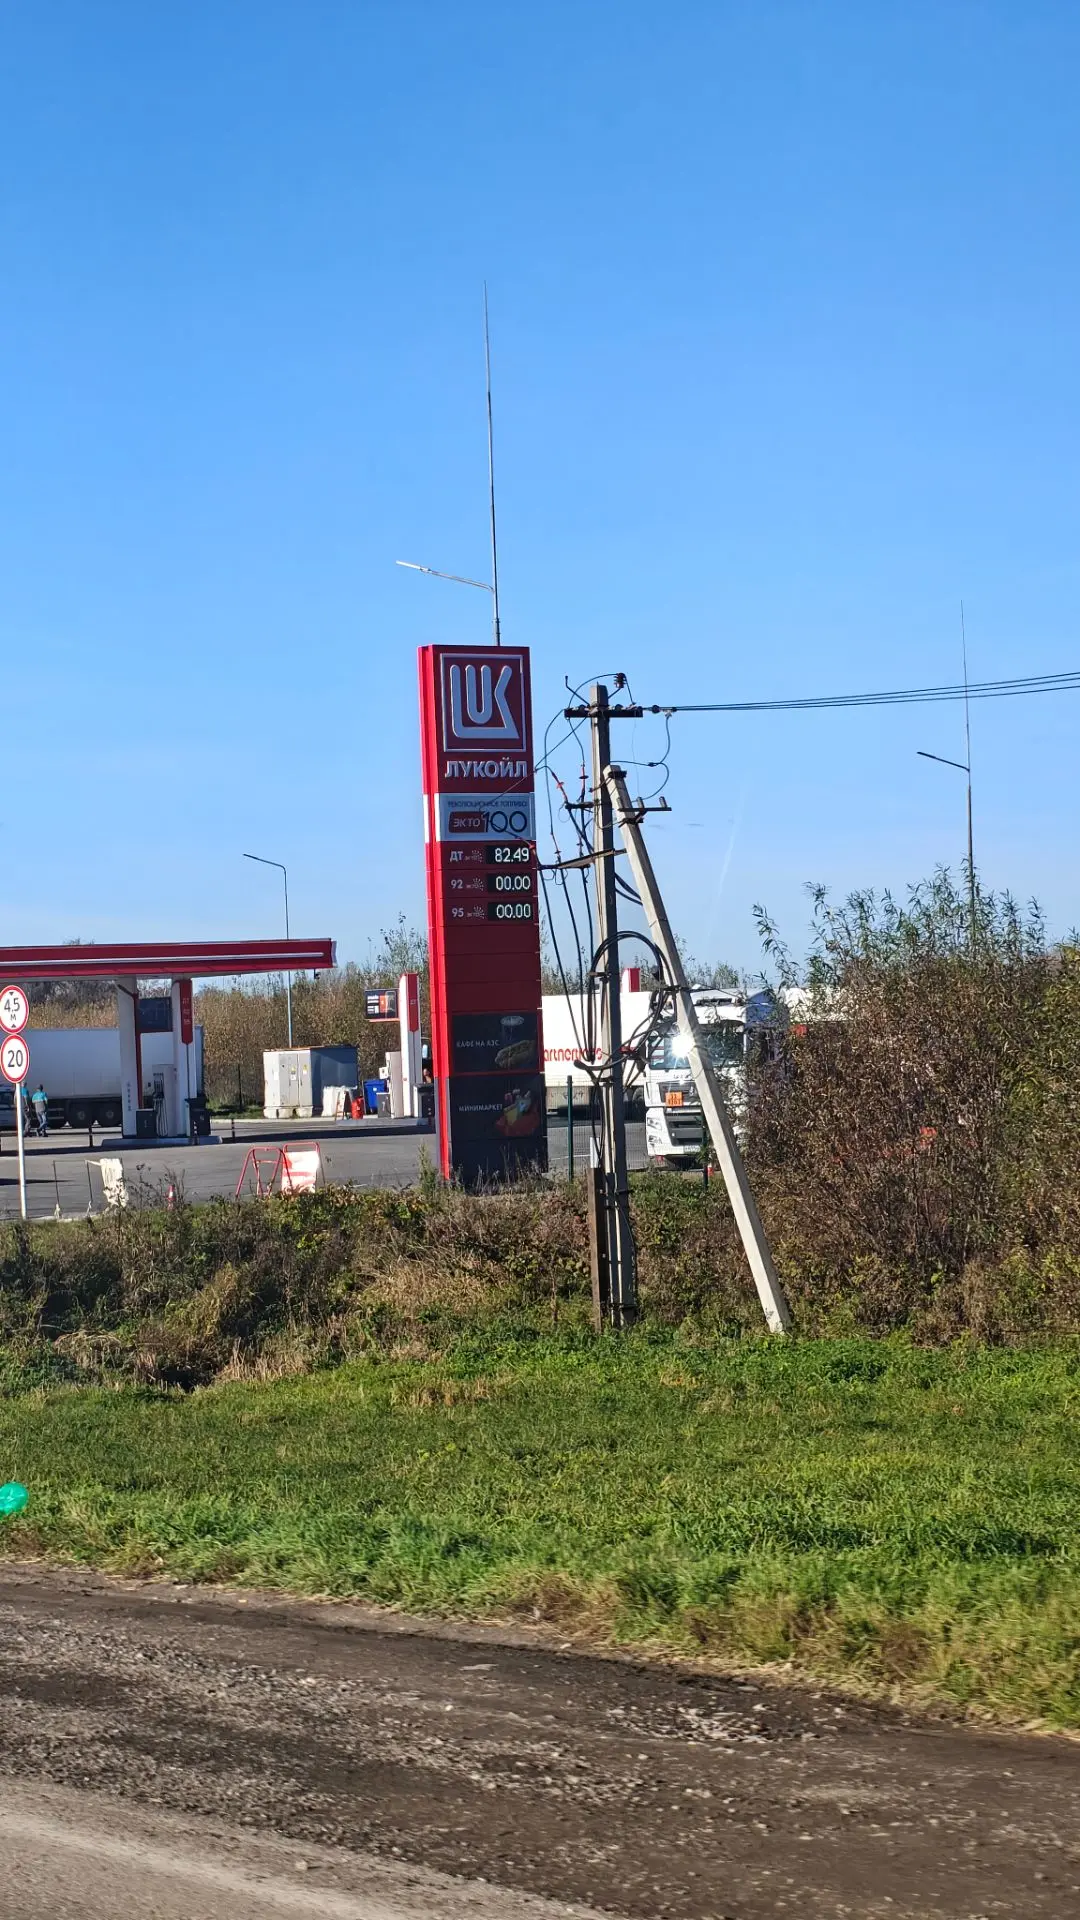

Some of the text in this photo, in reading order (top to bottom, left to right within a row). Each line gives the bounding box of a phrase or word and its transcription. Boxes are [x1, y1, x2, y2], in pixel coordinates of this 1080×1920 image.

[445, 757, 528, 778] ЛУКОЙЛ
[452, 810, 528, 833] ЭКТО 100
[449, 850, 464, 862] ДТ
[494, 847, 530, 862] 82.49
[450, 879, 464, 889] 92
[495, 875, 531, 890] 00.00
[451, 907, 464, 917] 95
[496, 903, 531, 918] 00.00
[7, 1049, 24, 1068] 20
